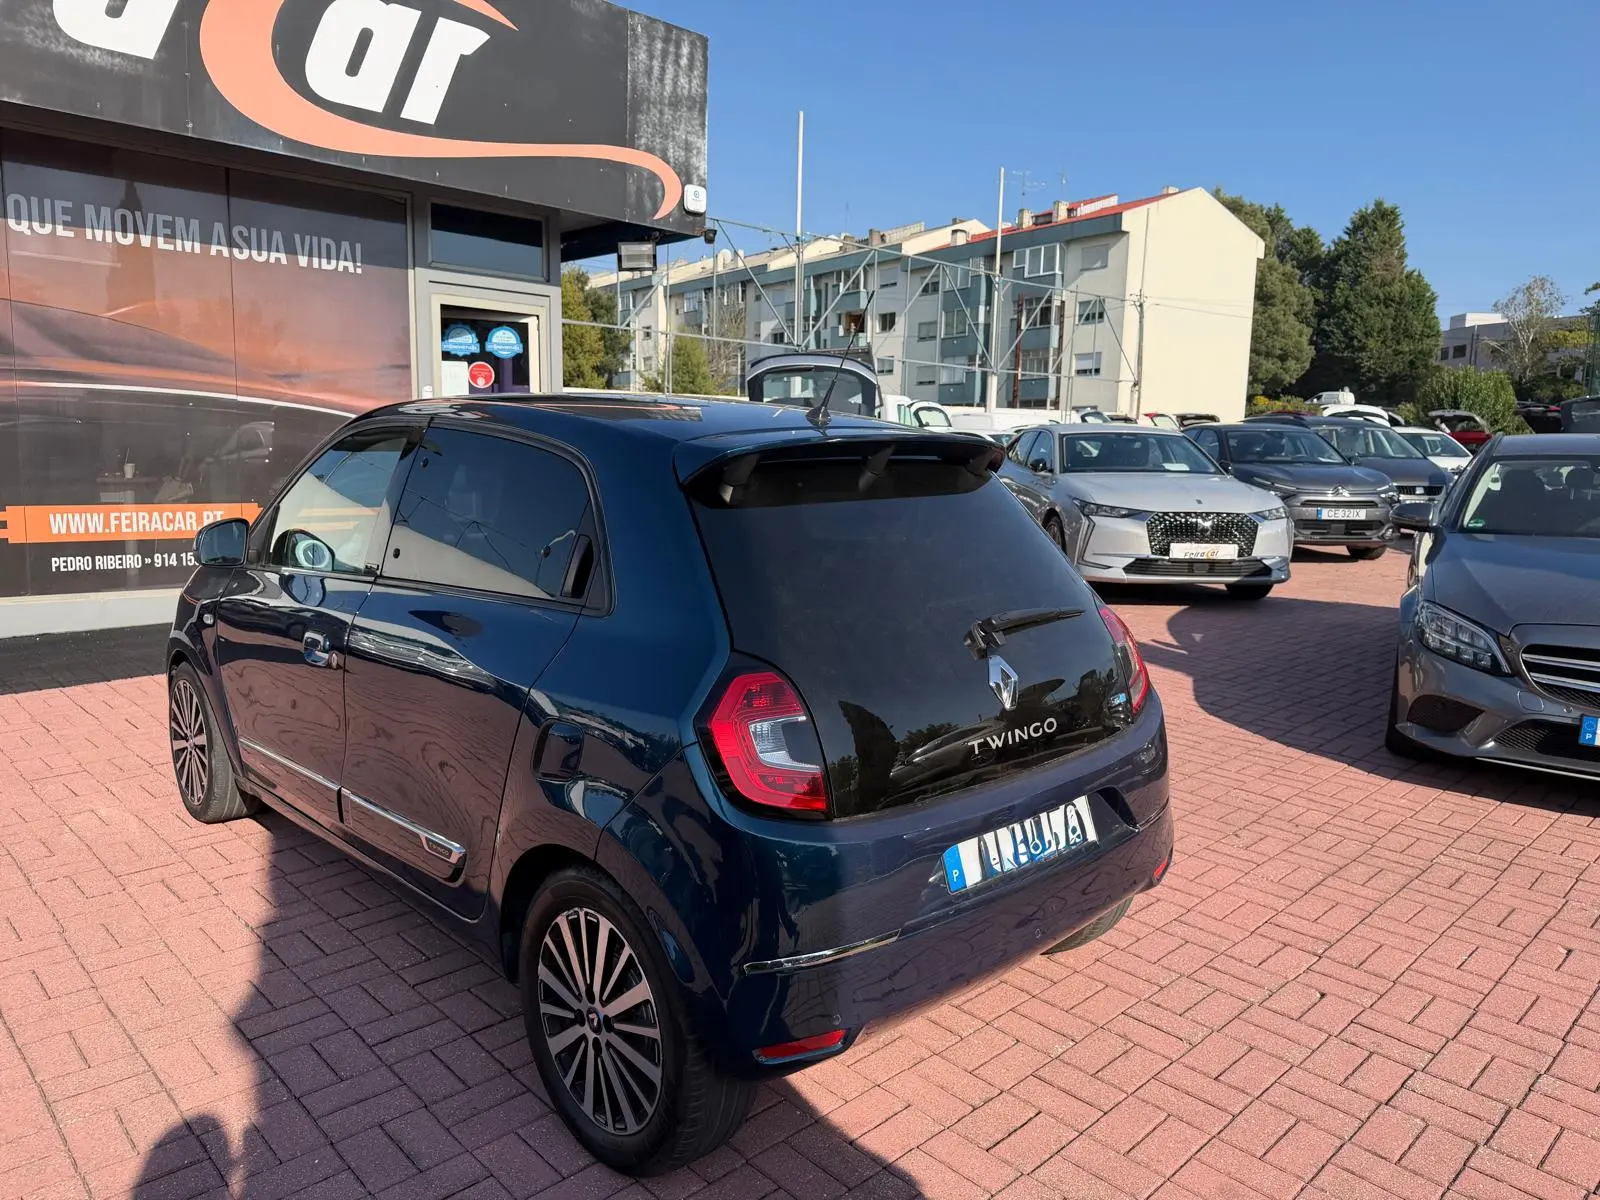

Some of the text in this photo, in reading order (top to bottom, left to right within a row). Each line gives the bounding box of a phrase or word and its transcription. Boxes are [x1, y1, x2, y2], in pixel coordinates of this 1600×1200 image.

[6, 193, 75, 238] QUE
[84, 203, 201, 254] MOVEM
[294, 233, 363, 274] VIDA!
[51, 555, 92, 572] PEDRO
[95, 554, 142, 570] RIBEIRO
[154, 552, 177, 567] 914
[180, 552, 200, 566] 15
[967, 717, 1057, 755] TWINGO
[1585, 732, 1593, 740] P
[952, 869, 960, 882] P
